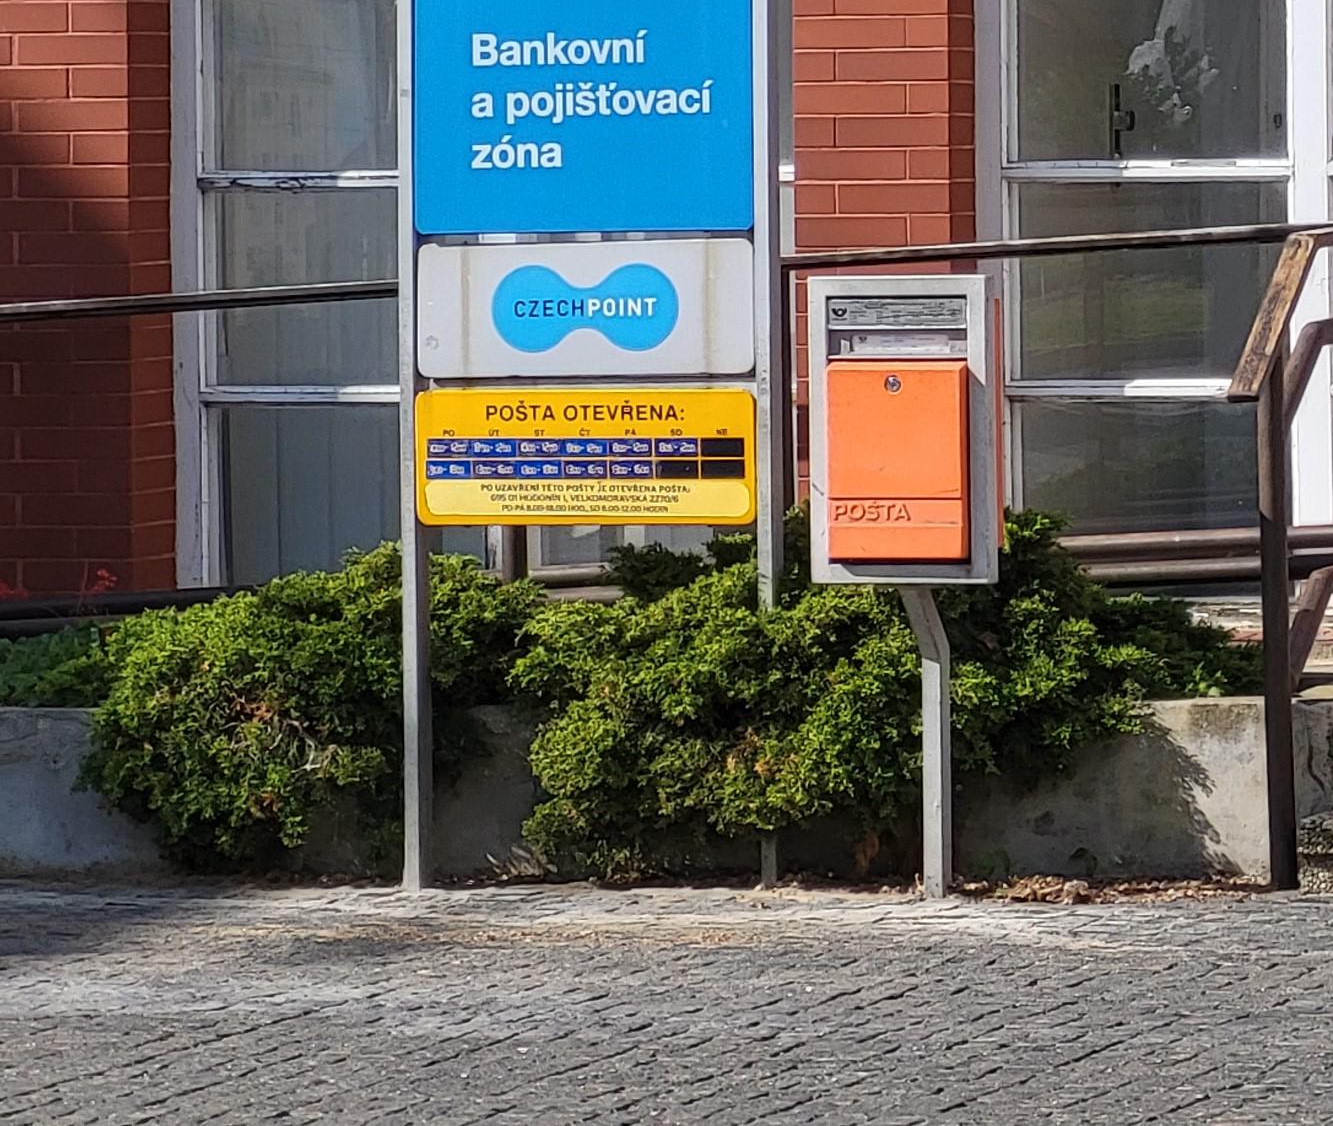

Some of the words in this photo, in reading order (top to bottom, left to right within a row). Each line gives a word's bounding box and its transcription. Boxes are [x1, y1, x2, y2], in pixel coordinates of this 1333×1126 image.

[471, 29, 647, 67] Bankovní
[471, 91, 494, 119] a
[505, 79, 714, 127] pojišťovací
[471, 135, 563, 170] zóna
[486, 400, 554, 422] POŠTA
[563, 399, 686, 422] OTEVŘENA:
[480, 484, 493, 492] PO
[833, 501, 912, 522] POŠTA
